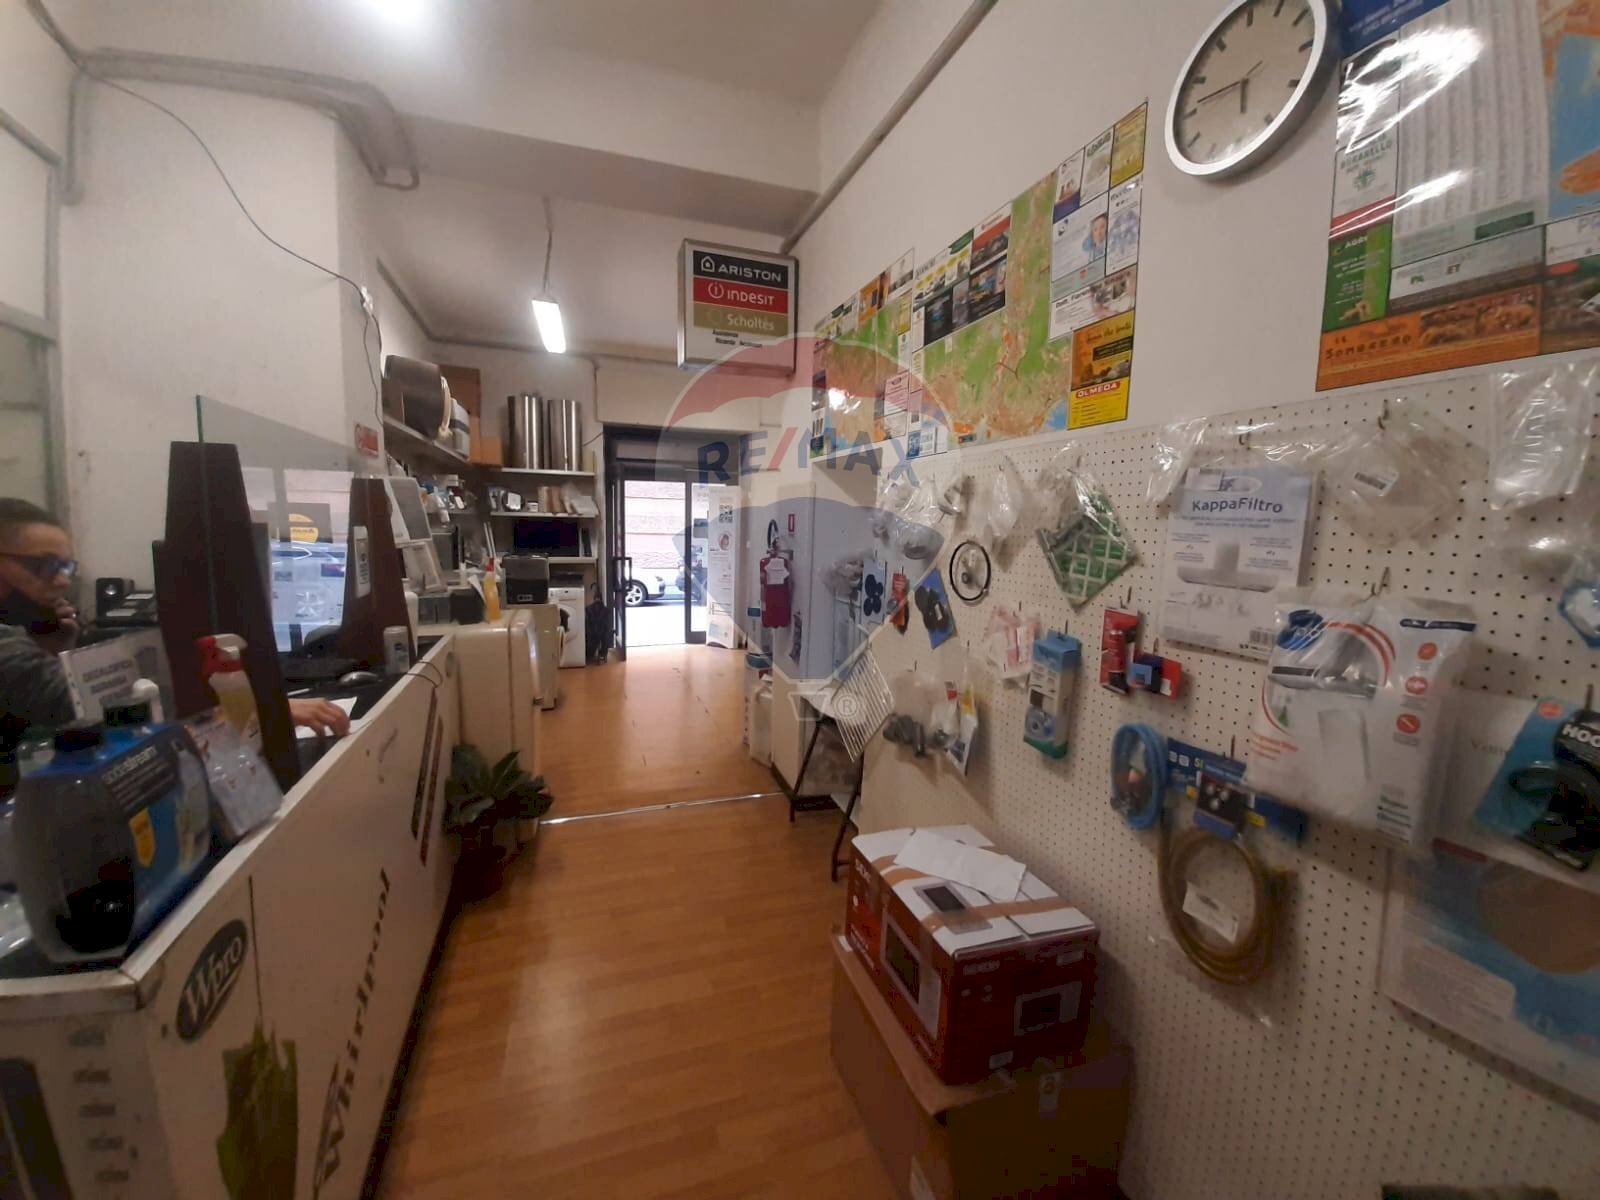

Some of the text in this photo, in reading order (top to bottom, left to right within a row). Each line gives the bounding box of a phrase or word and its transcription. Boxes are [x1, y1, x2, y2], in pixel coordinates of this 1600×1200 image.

[718, 264, 781, 282] ARISTON
[727, 289, 775, 305] INDESIT
[1192, 497, 1284, 514] KappaFiltro
[186, 936, 242, 1023] Wpro
